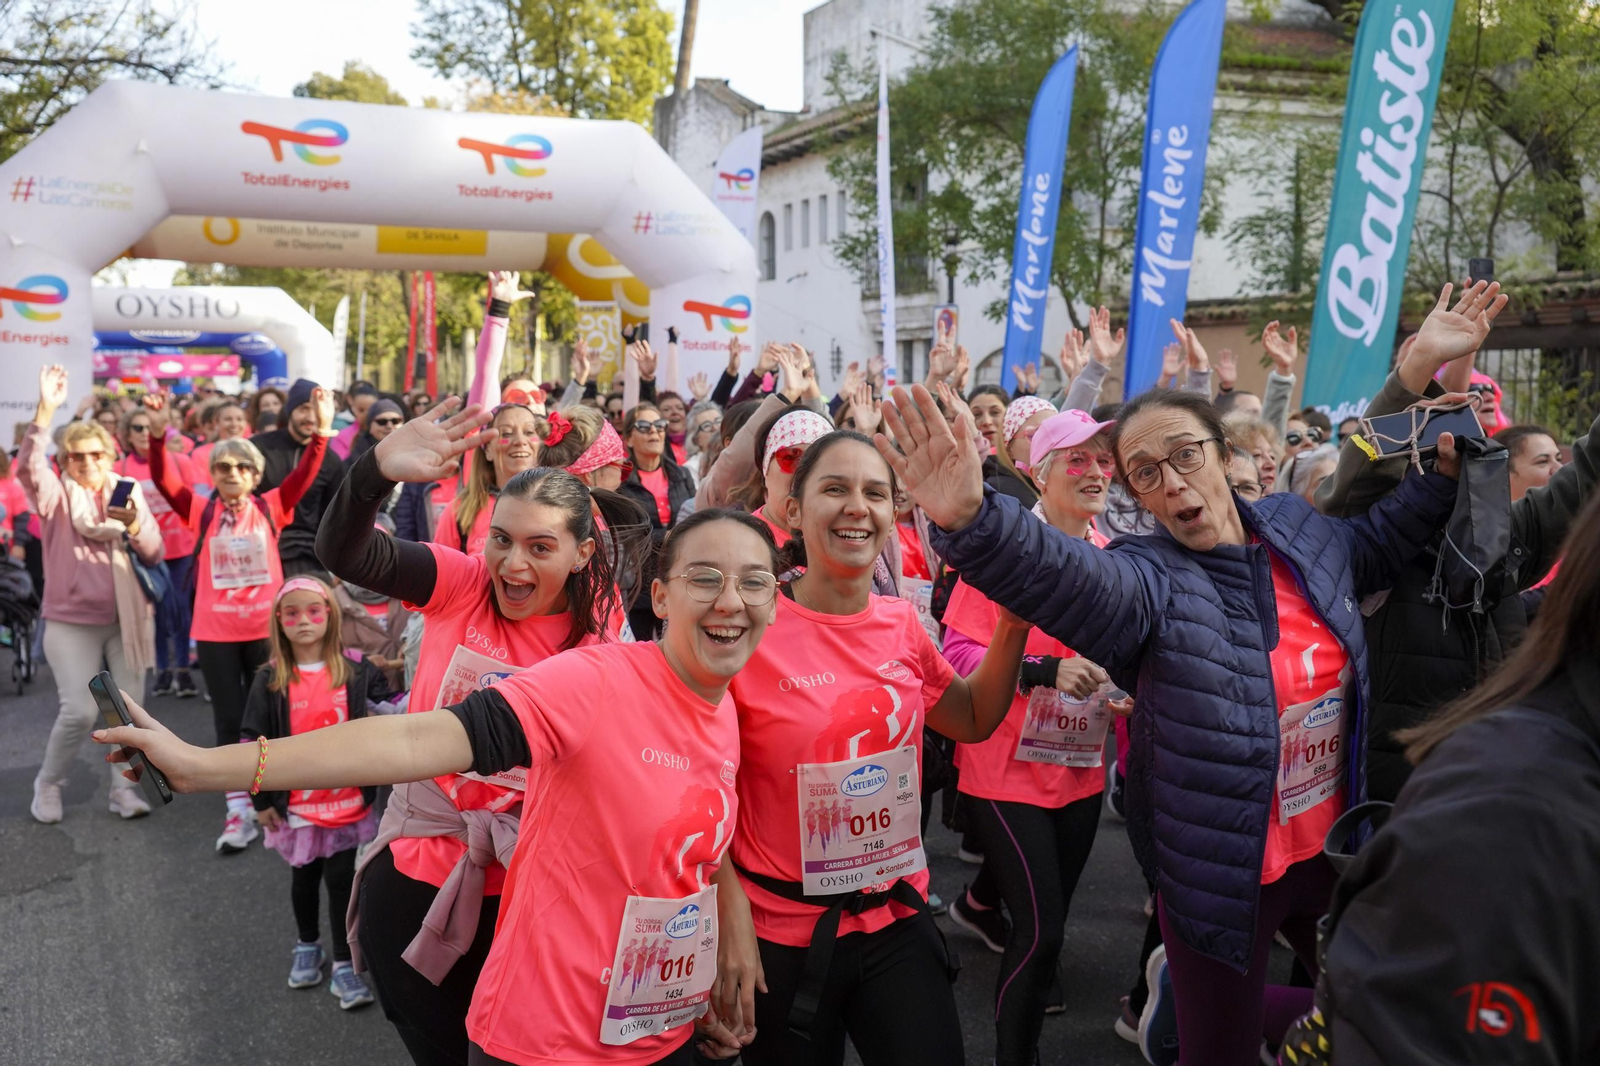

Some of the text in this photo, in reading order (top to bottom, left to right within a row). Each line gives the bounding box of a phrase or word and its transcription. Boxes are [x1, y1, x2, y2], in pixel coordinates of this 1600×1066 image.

[241, 172, 350, 192] TotalEnergies
[1328, 9, 1435, 347] Batiste
[457, 184, 553, 203] TotalEnergies
[1140, 124, 1194, 308] Marlene
[257, 223, 360, 239] Instituto Municipal
[406, 229, 460, 241] DE SEVILLA
[274, 239, 344, 251] de Deportes
[1012, 172, 1050, 332] Marlene
[115, 293, 240, 319] OYSHO
[466, 625, 508, 660] OYSHO
[454, 669, 477, 684] SUMA
[779, 672, 836, 692] OYSHO
[1057, 715, 1088, 731] 016
[1027, 749, 1057, 760] OYSHO
[1305, 734, 1340, 764] 016
[642, 747, 690, 771] OYSHO
[1313, 763, 1327, 775] 659
[845, 774, 886, 792] ASTURIANA
[1283, 786, 1305, 798] CARRERA
[1305, 781, 1312, 789] DE
[1311, 778, 1318, 787] LA
[809, 787, 838, 797] SUMA
[850, 807, 891, 836] 016
[862, 839, 885, 853] 7148
[824, 843, 909, 870] CARRERA DE LA MUJER SEVILLA
[885, 858, 915, 874] Santander
[820, 872, 864, 888] OYSHO
[634, 925, 661, 934] SUMA
[669, 917, 699, 934] ASTURIAN
[659, 953, 695, 982] 016
[665, 988, 684, 1000] 1434
[625, 1005, 652, 1015] CARRERA
[652, 1004, 660, 1012] DE
[660, 1003, 668, 1011] LA
[620, 1019, 653, 1036] OYSHO
